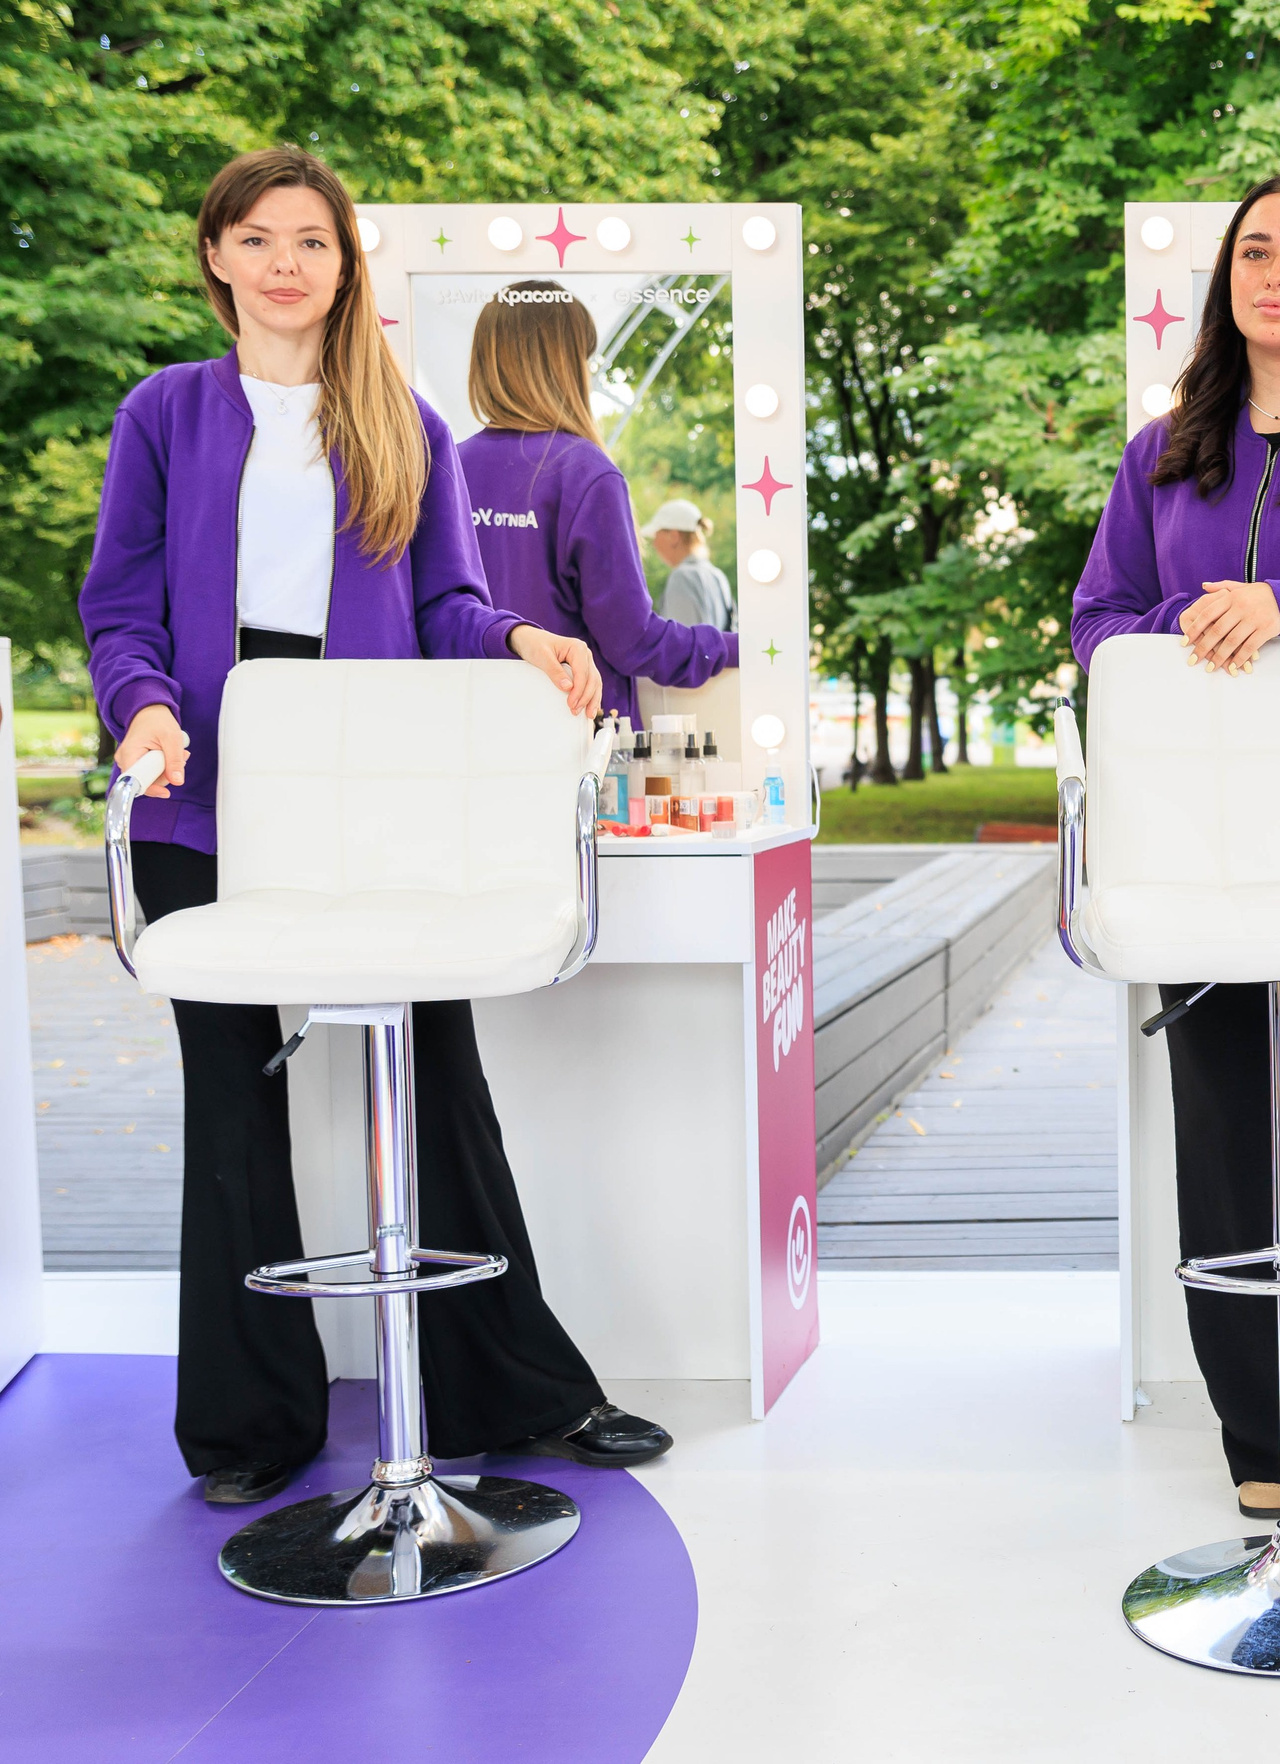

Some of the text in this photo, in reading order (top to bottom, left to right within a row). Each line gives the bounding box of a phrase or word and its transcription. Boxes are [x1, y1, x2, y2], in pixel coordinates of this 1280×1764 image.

[498, 287, 574, 307] Красота
[615, 287, 711, 305] essence
[767, 887, 797, 965] MAKE
[763, 917, 806, 1024] BEAUTY
[773, 973, 804, 1073] FUN
